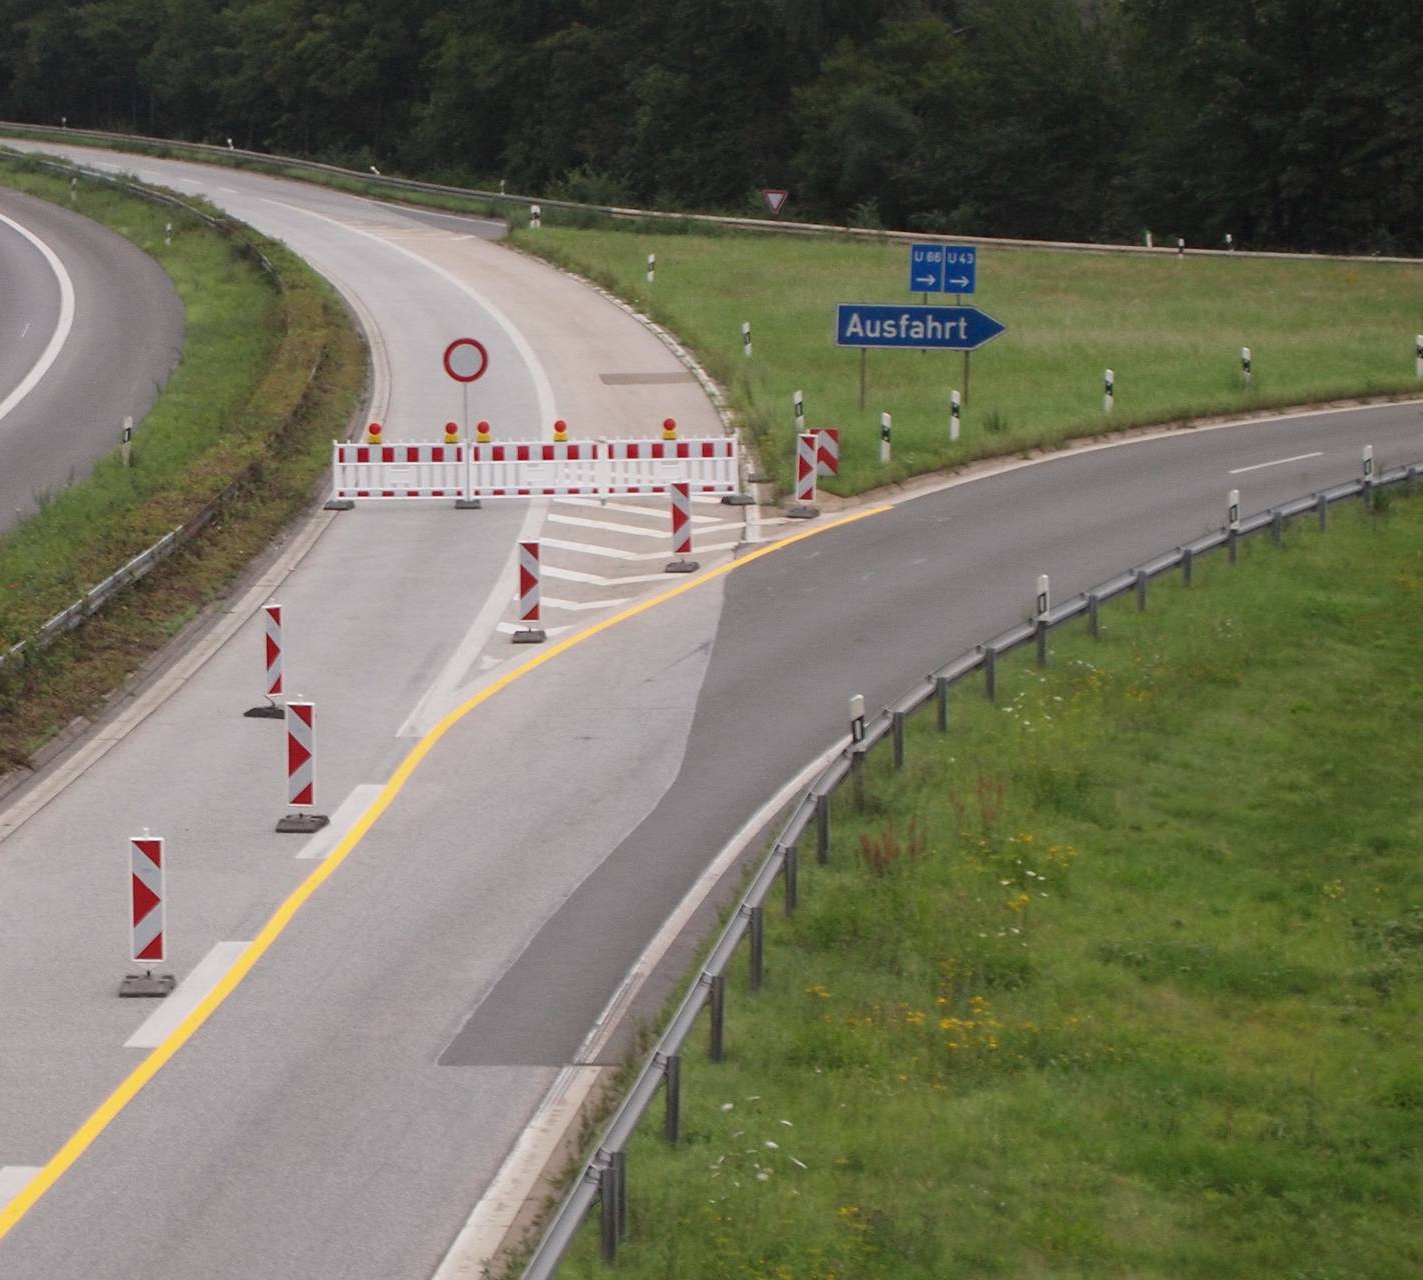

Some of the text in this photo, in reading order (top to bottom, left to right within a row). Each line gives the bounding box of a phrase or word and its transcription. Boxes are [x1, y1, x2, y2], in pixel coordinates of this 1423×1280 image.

[914, 251, 924, 263] U
[947, 252, 974, 265] U 43
[846, 312, 968, 340] Ausfahrt
